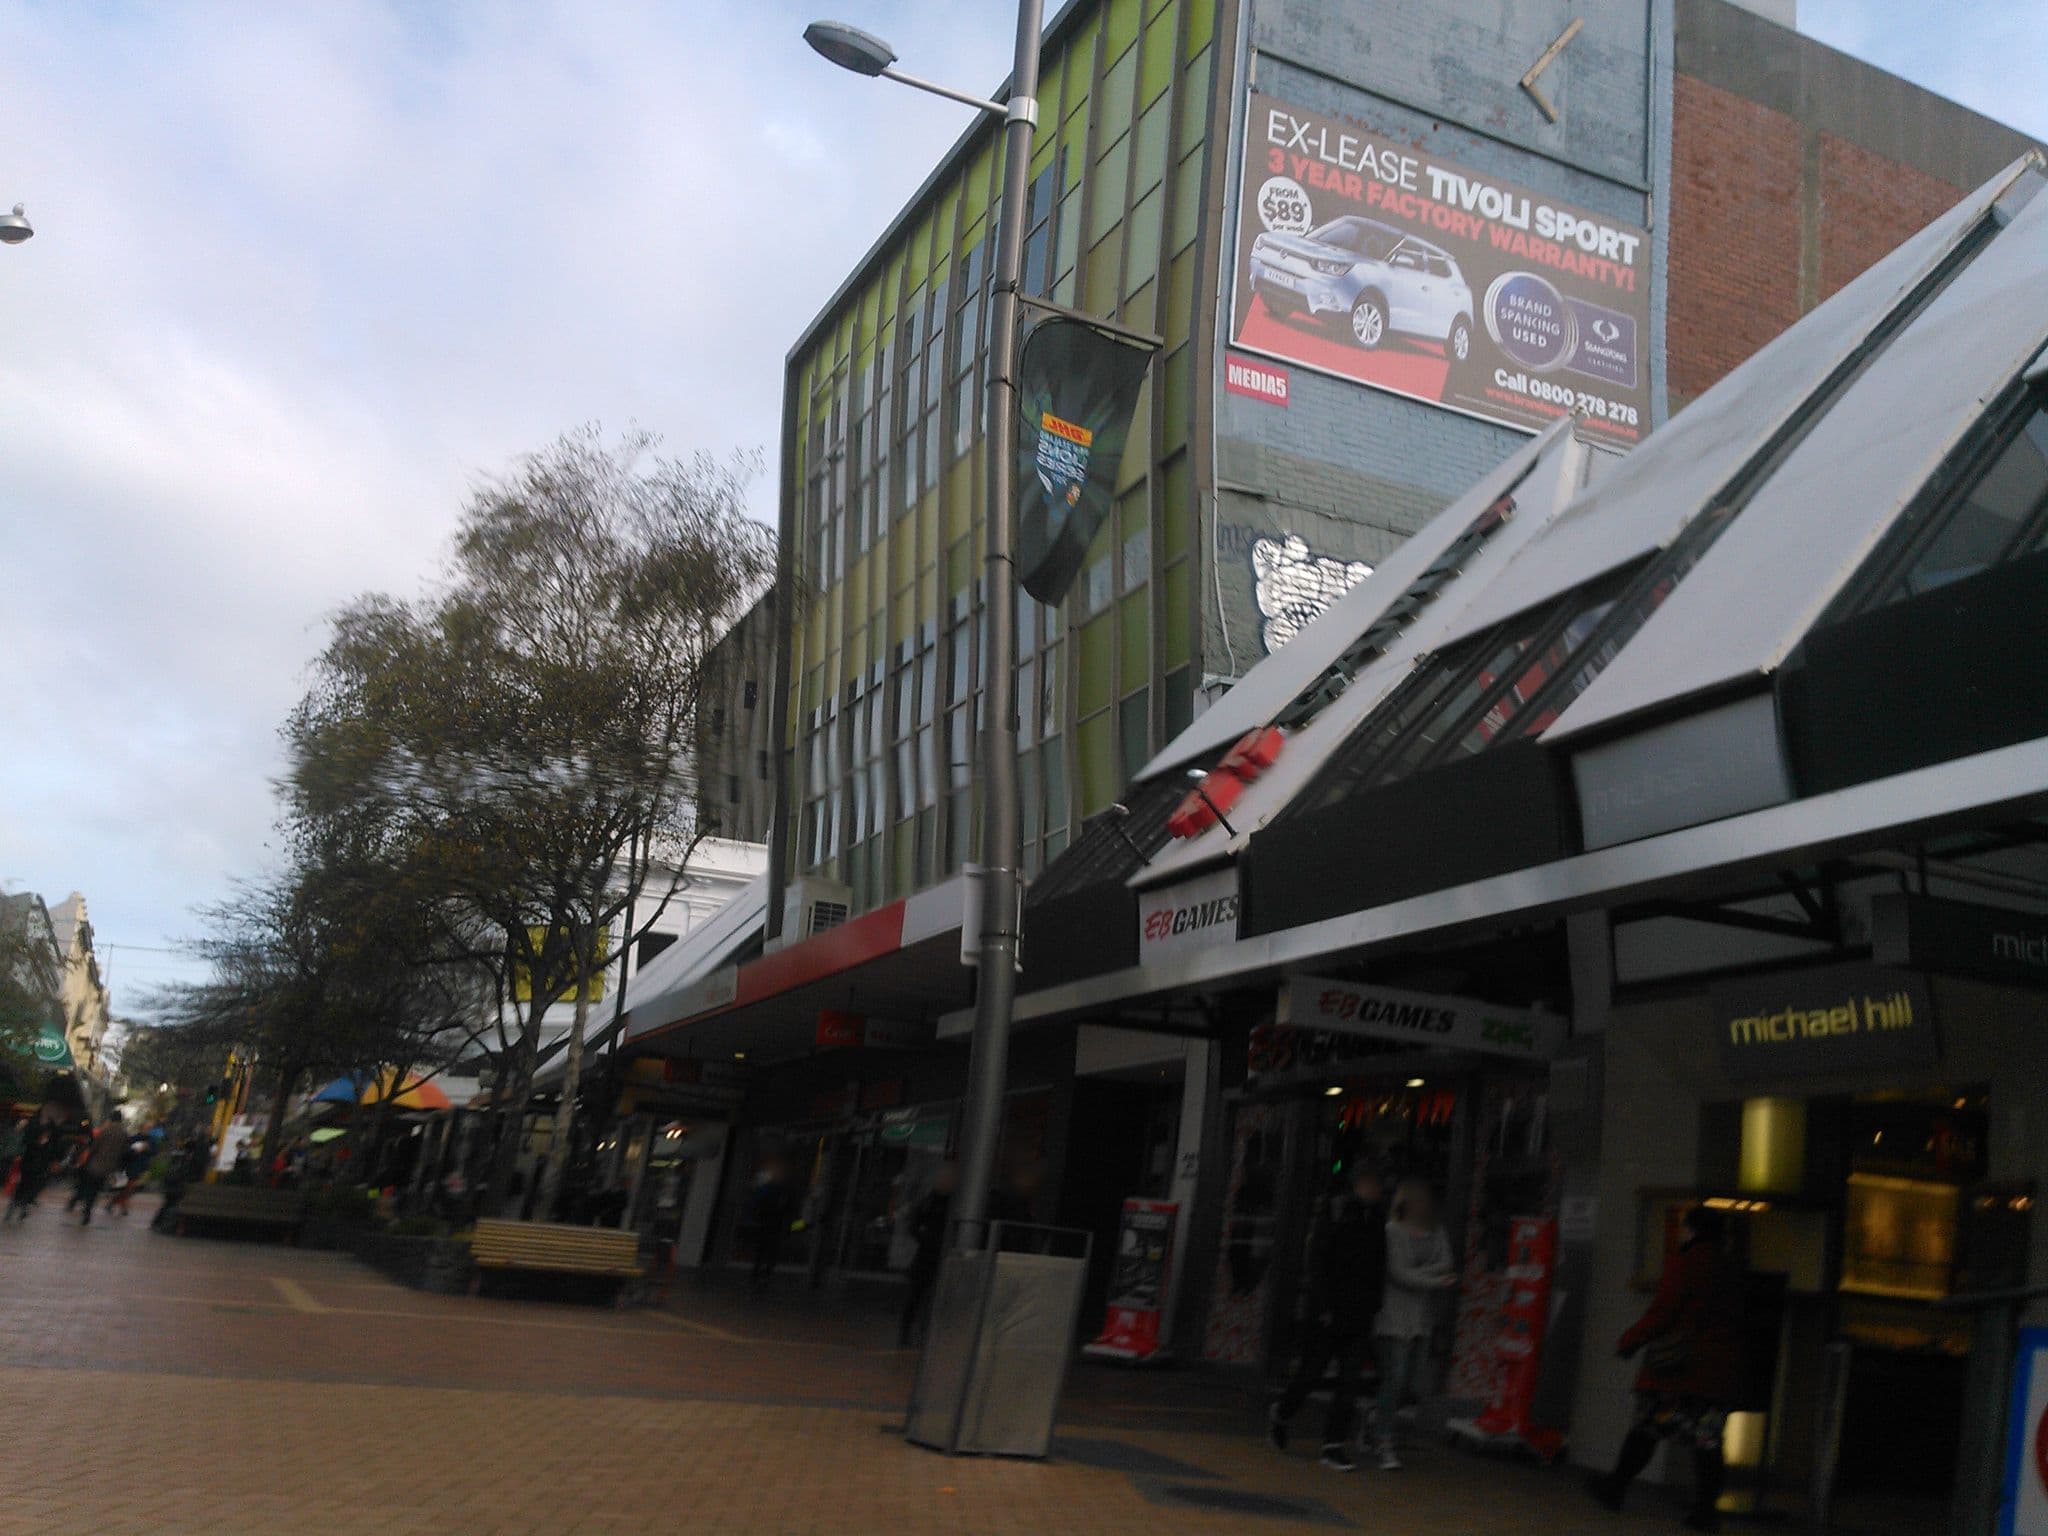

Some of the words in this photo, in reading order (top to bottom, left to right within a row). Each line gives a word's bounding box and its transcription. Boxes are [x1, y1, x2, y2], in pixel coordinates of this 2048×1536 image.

[1266, 110, 1418, 191] EX-LEASE
[1426, 165, 1530, 231] TIVOLI
[1534, 207, 1640, 266] SPORT
[1269, 186, 1299, 199] FROM
[1267, 148, 1285, 175] 3
[1291, 155, 1363, 201] YEAR
[1366, 179, 1485, 241] FACTORY
[1488, 221, 1636, 292] WARRANTY!
[1509, 294, 1553, 318] BRAND
[1512, 327, 1548, 348] USED
[1228, 363, 1288, 400] MEDIA5
[1494, 367, 1528, 394] Call
[1529, 379, 1575, 406] 0800
[1575, 391, 1607, 418] 278
[1608, 401, 1639, 426] 278
[1145, 909, 1174, 941] EB
[1172, 894, 1239, 936] GAMES
[1318, 988, 1361, 1022] EB
[1358, 997, 1457, 1034] GAMES
[1729, 995, 1858, 1047] michael
[1863, 991, 1913, 1033] hill
